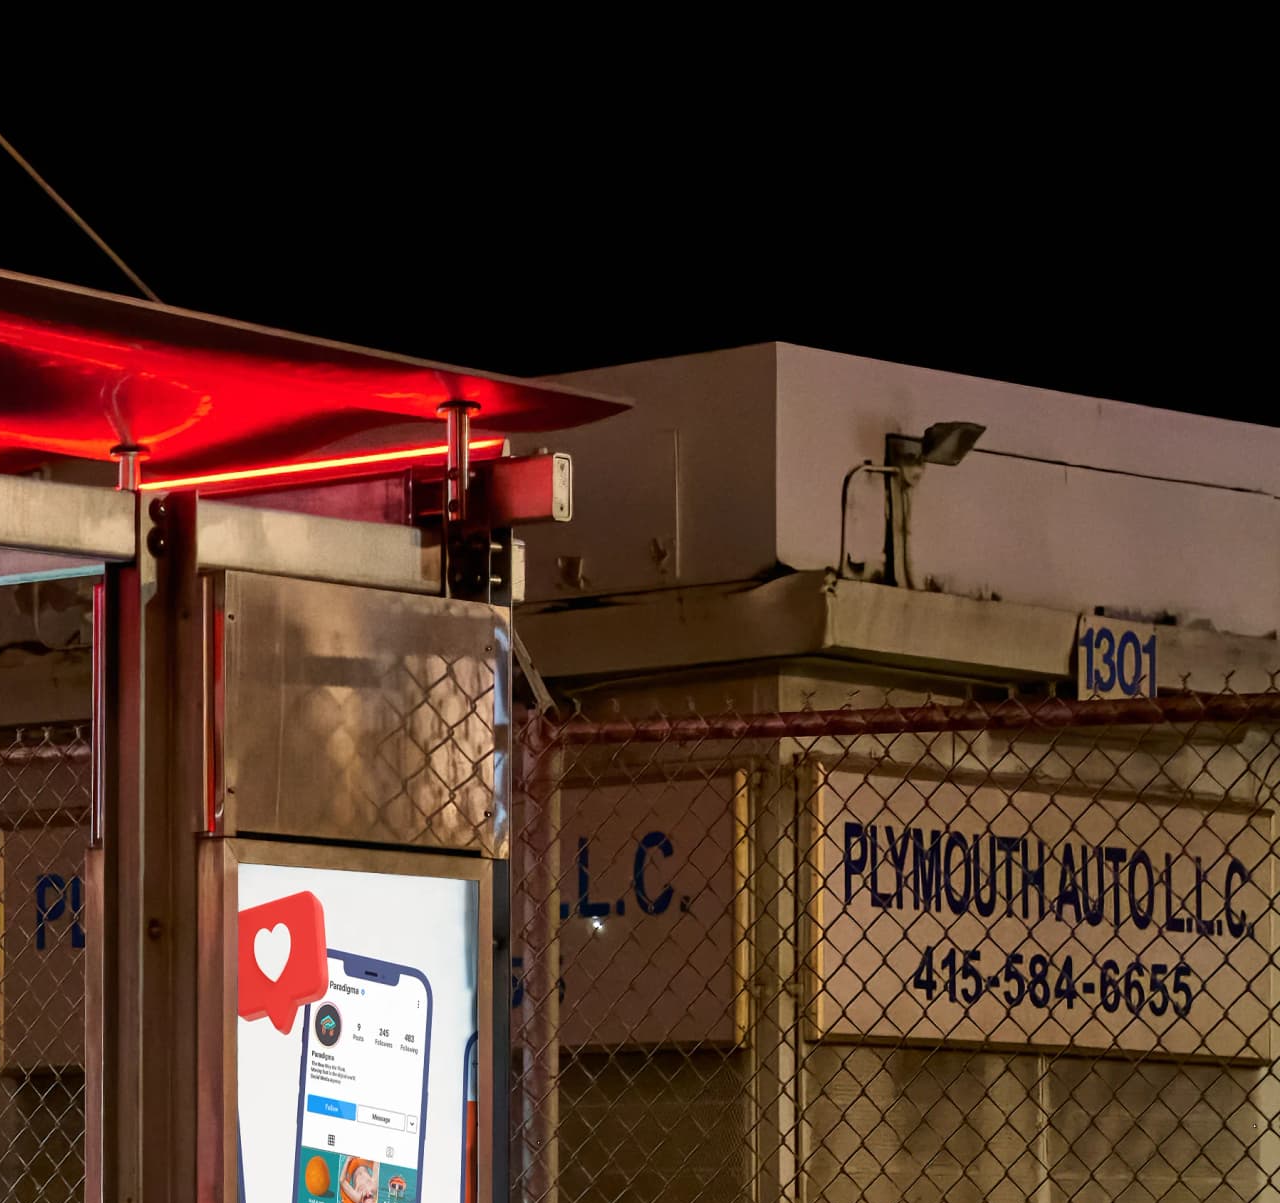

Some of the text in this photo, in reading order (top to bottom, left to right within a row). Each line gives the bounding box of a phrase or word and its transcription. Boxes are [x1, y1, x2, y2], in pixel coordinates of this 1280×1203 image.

[1079, 627, 1157, 697] 1301
[844, 822, 1256, 938] PLYMOUTH AUTO L.L.C.
[329, 981, 360, 995] Paradigma
[914, 945, 1193, 1017] 415-584-6655
[400, 1044, 419, 1055] Following
[372, 1113, 391, 1124] Message
